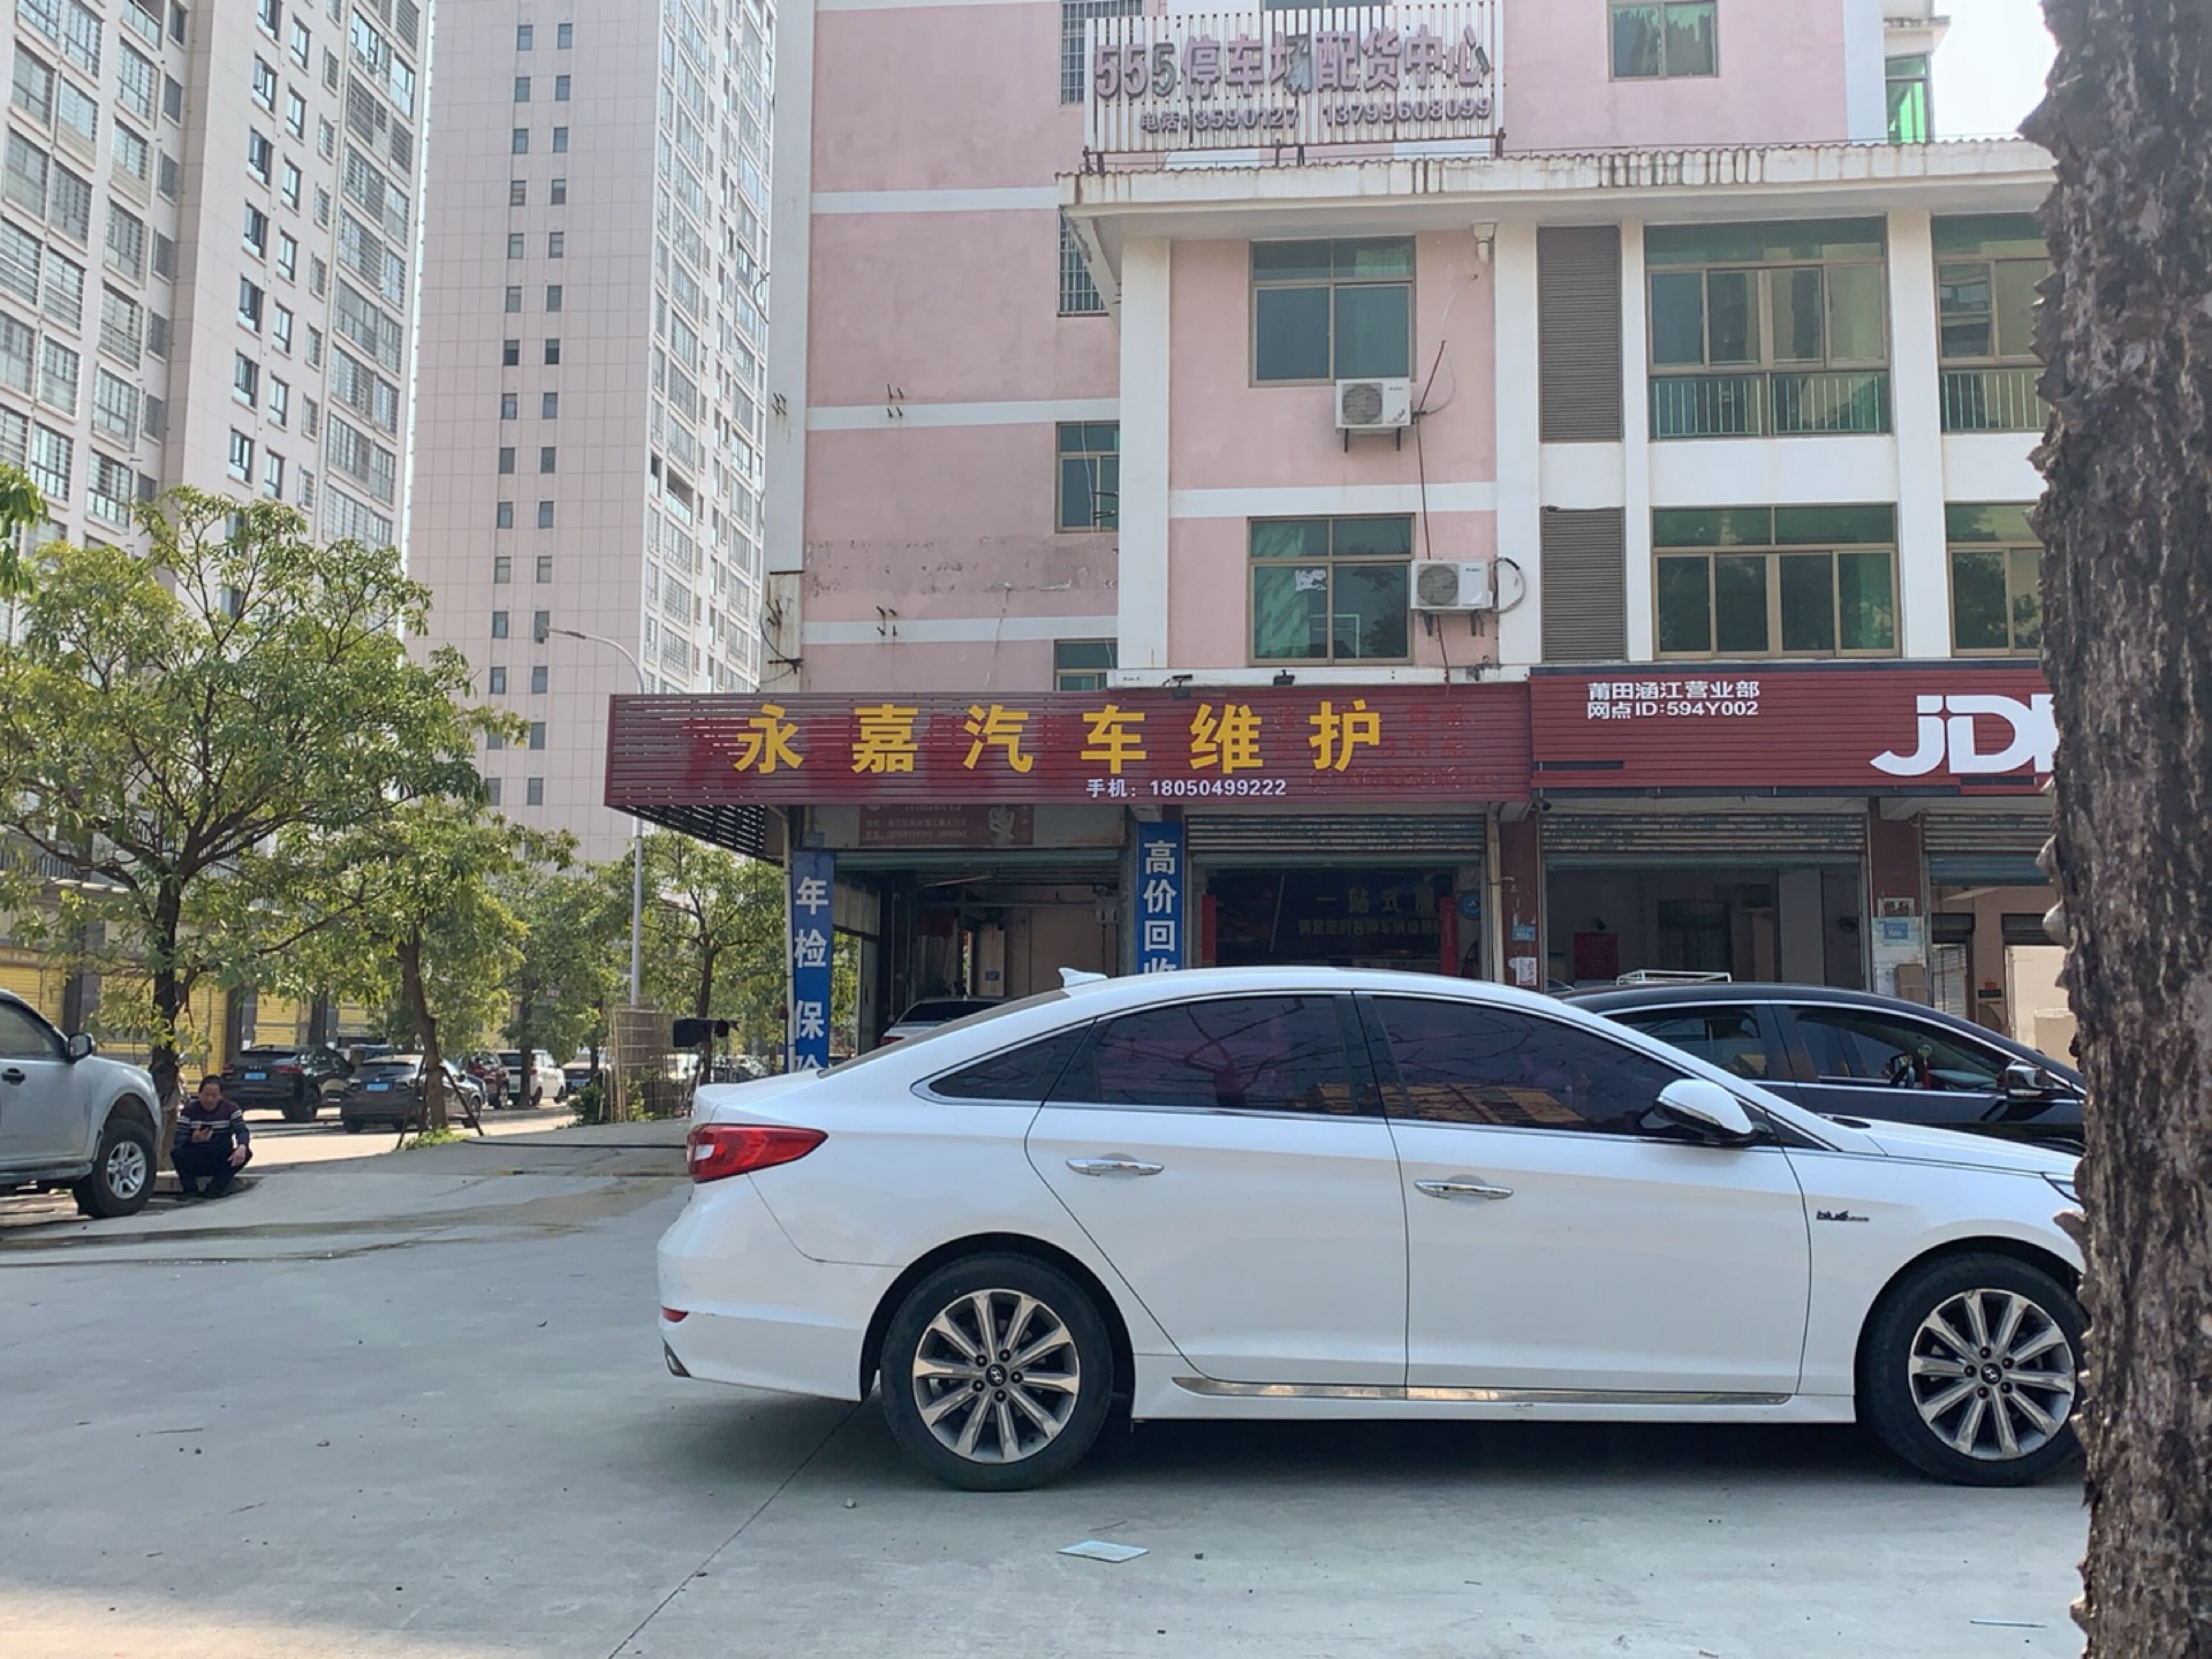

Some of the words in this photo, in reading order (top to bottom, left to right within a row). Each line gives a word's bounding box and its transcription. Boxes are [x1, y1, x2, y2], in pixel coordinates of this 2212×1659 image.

[1094, 24, 1490, 101] 555停车场配货中心
[1322, 97, 1492, 127] 13799608099
[1587, 680, 1760, 701] 莆田涵江营业部
[733, 699, 1381, 774] 永嘉汽车维护
